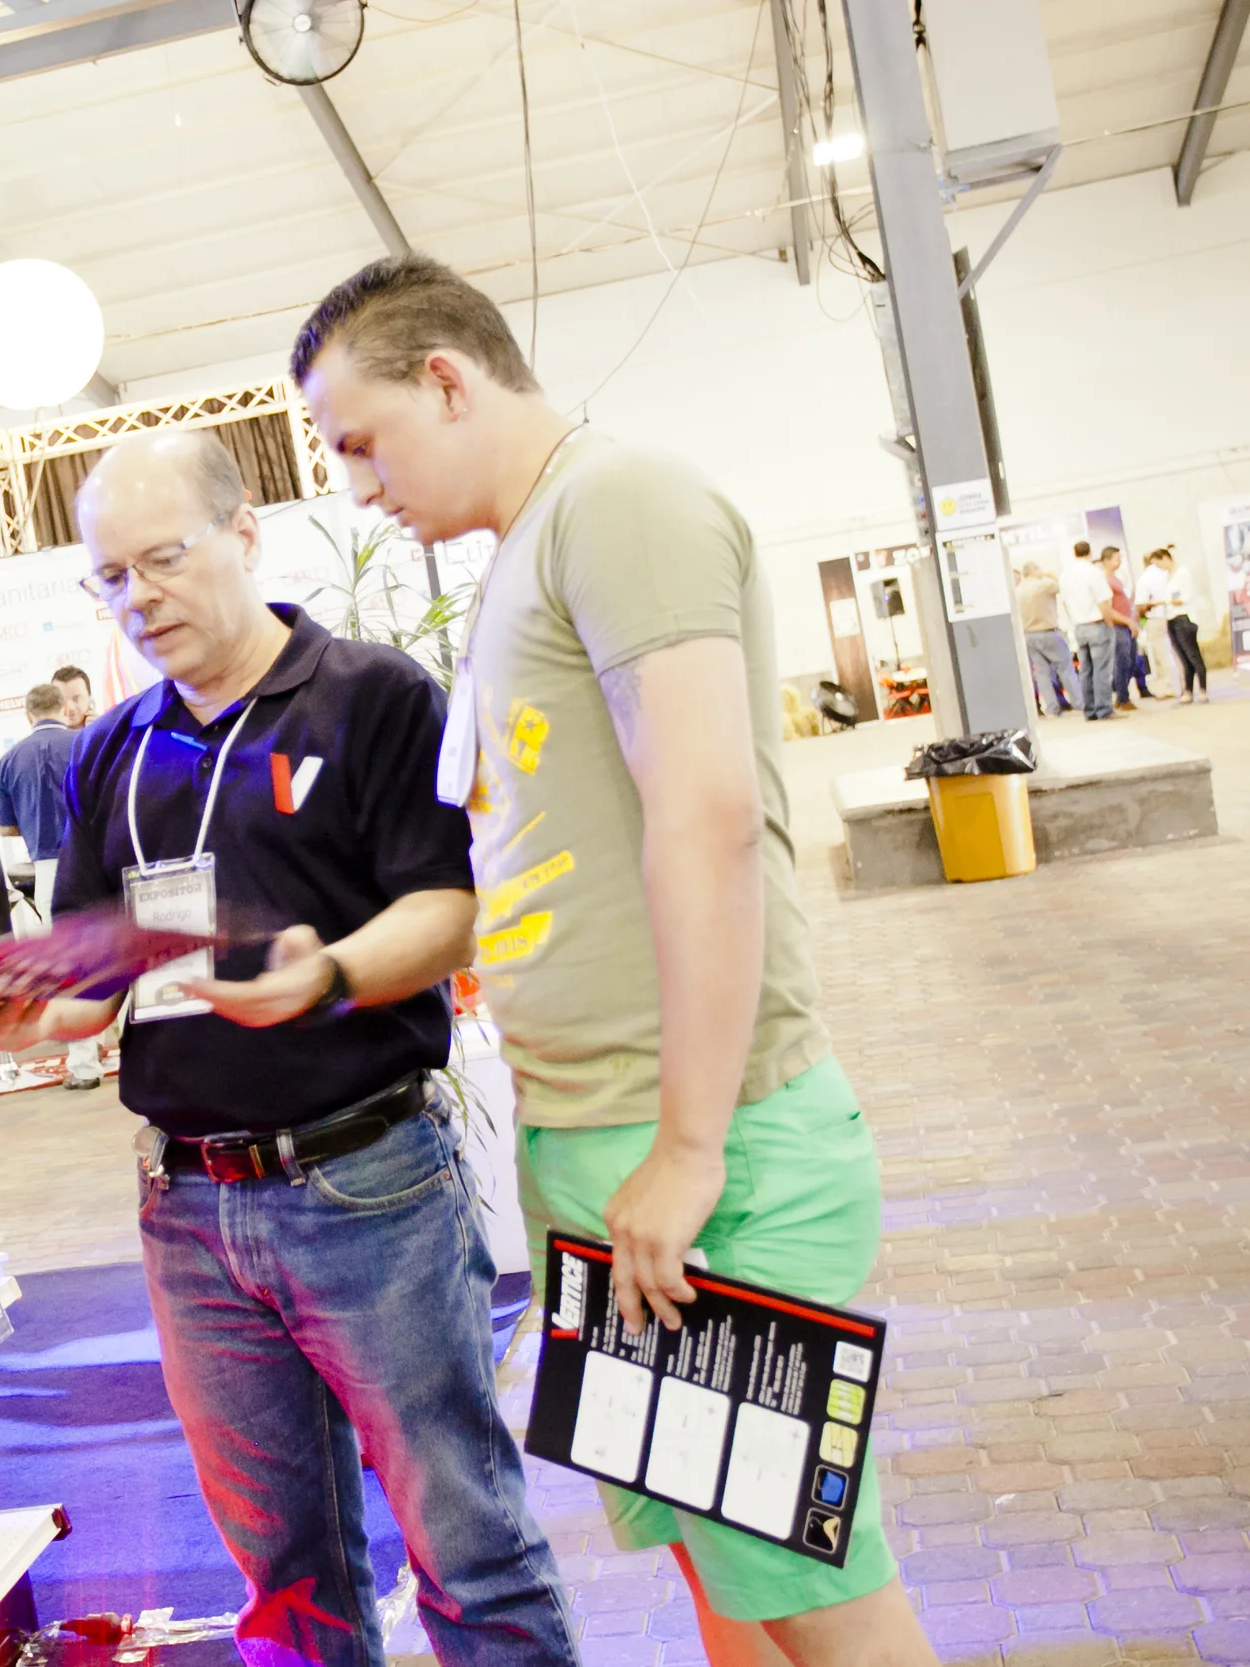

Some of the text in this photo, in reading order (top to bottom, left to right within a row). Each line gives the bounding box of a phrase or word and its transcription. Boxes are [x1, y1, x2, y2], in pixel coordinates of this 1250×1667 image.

[138, 883, 202, 903] EXPOSITOR
[152, 908, 192, 923] Rodrigo
[550, 1251, 584, 1339] VERTICE
